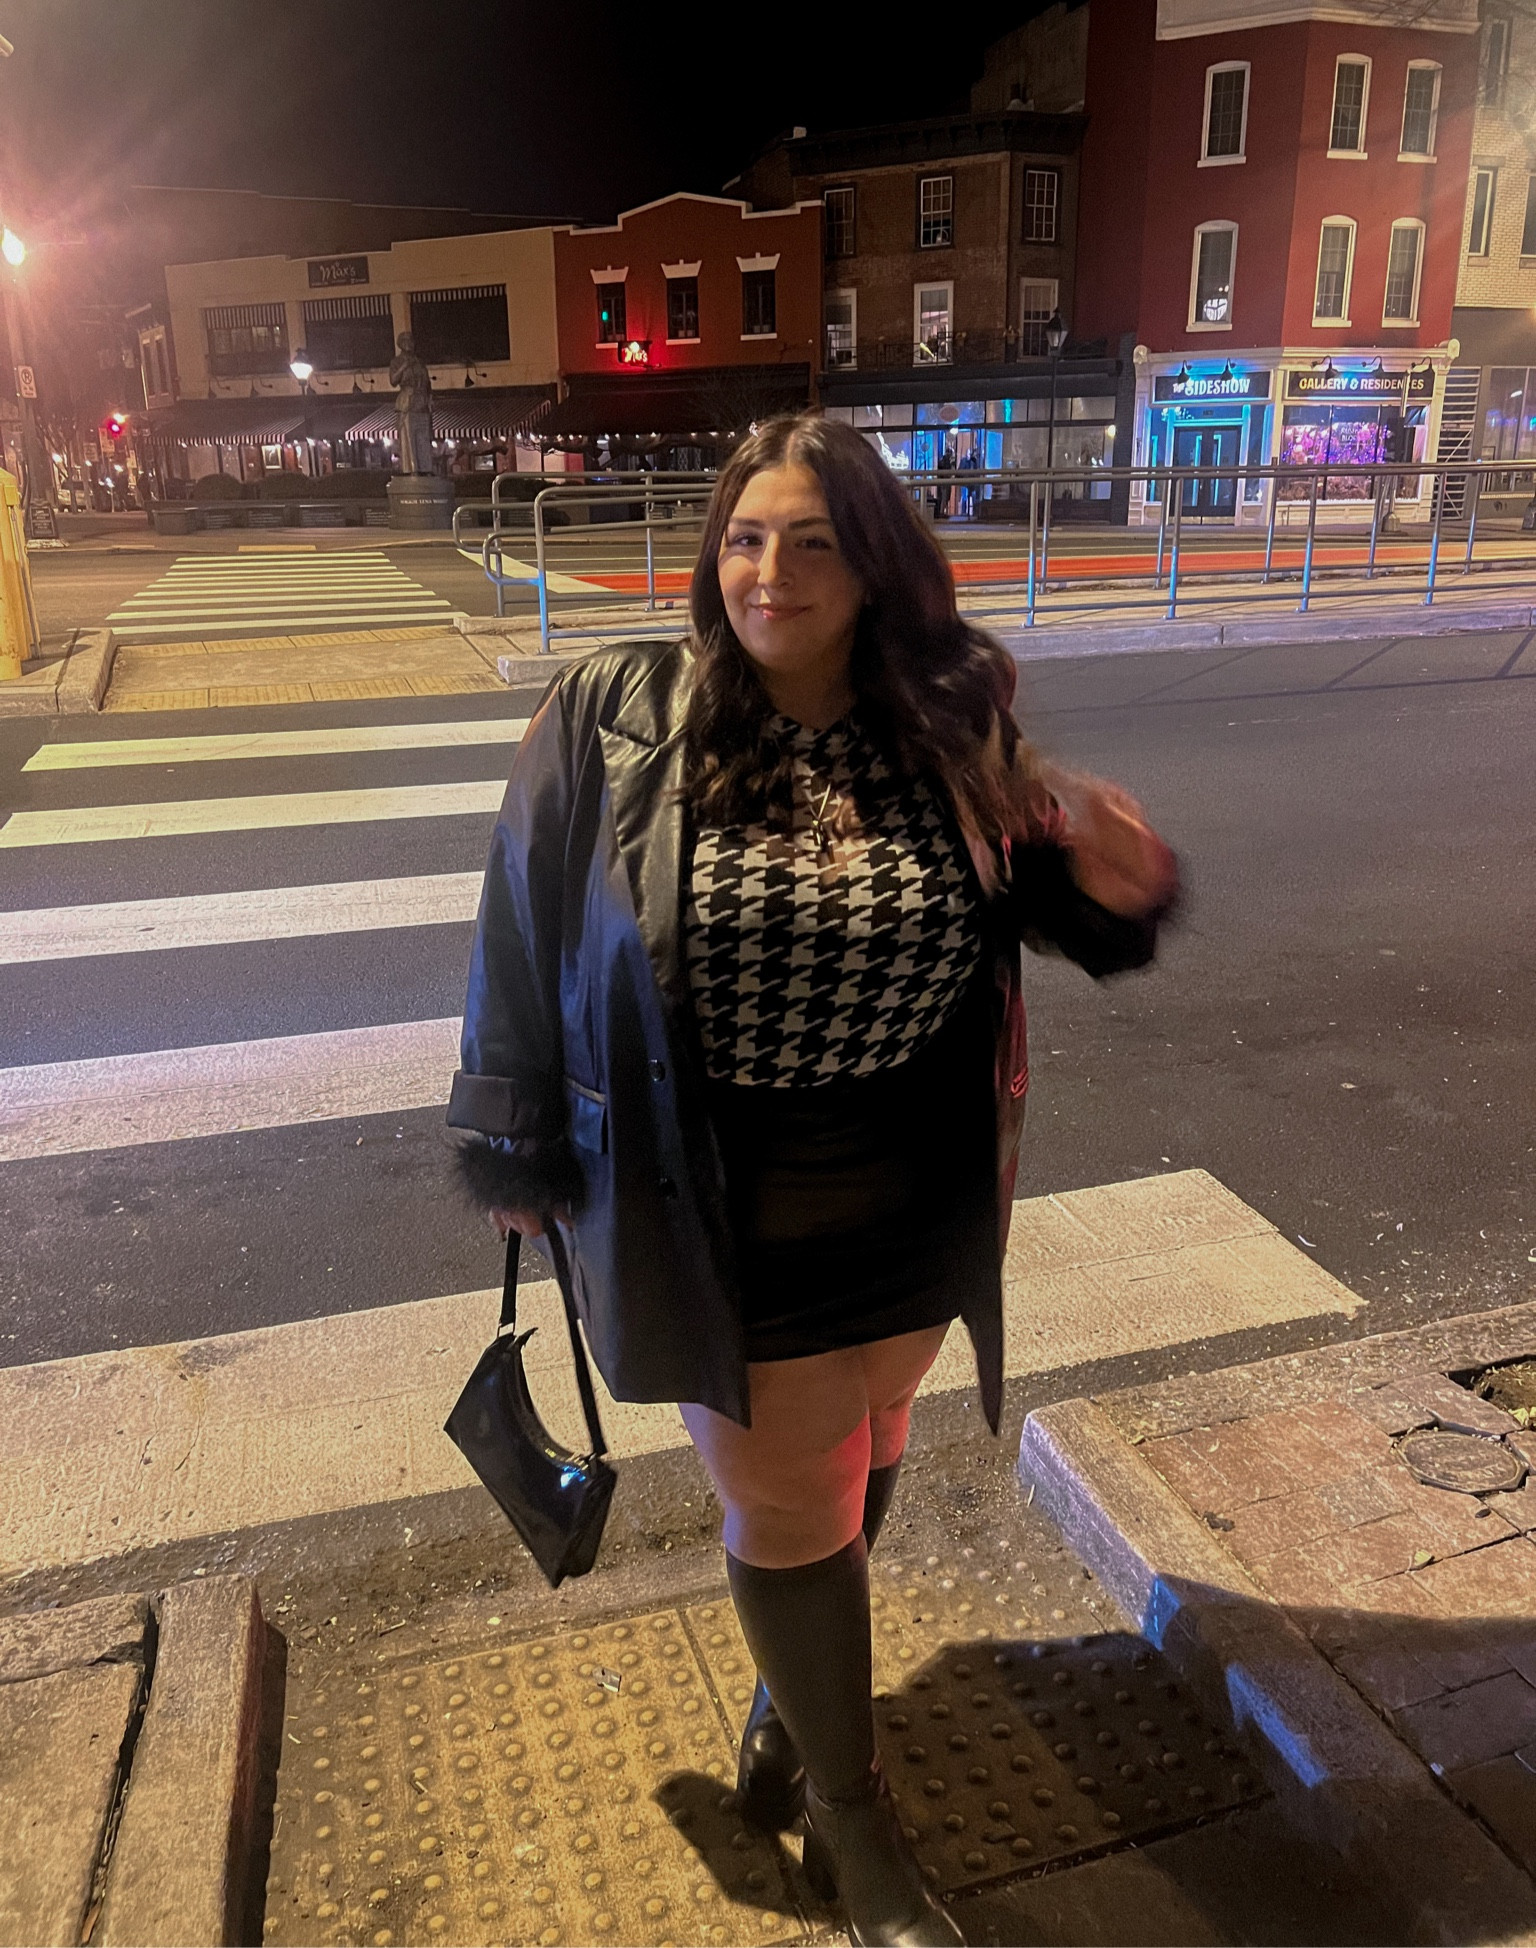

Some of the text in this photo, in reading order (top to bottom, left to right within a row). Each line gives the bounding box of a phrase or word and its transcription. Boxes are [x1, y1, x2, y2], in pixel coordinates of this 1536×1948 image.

[320, 264, 356, 281] Max's
[1185, 379, 1250, 396] SIDESHOW
[1299, 378, 1348, 390] GALLERY
[1360, 379, 1424, 390] RESIDENES
